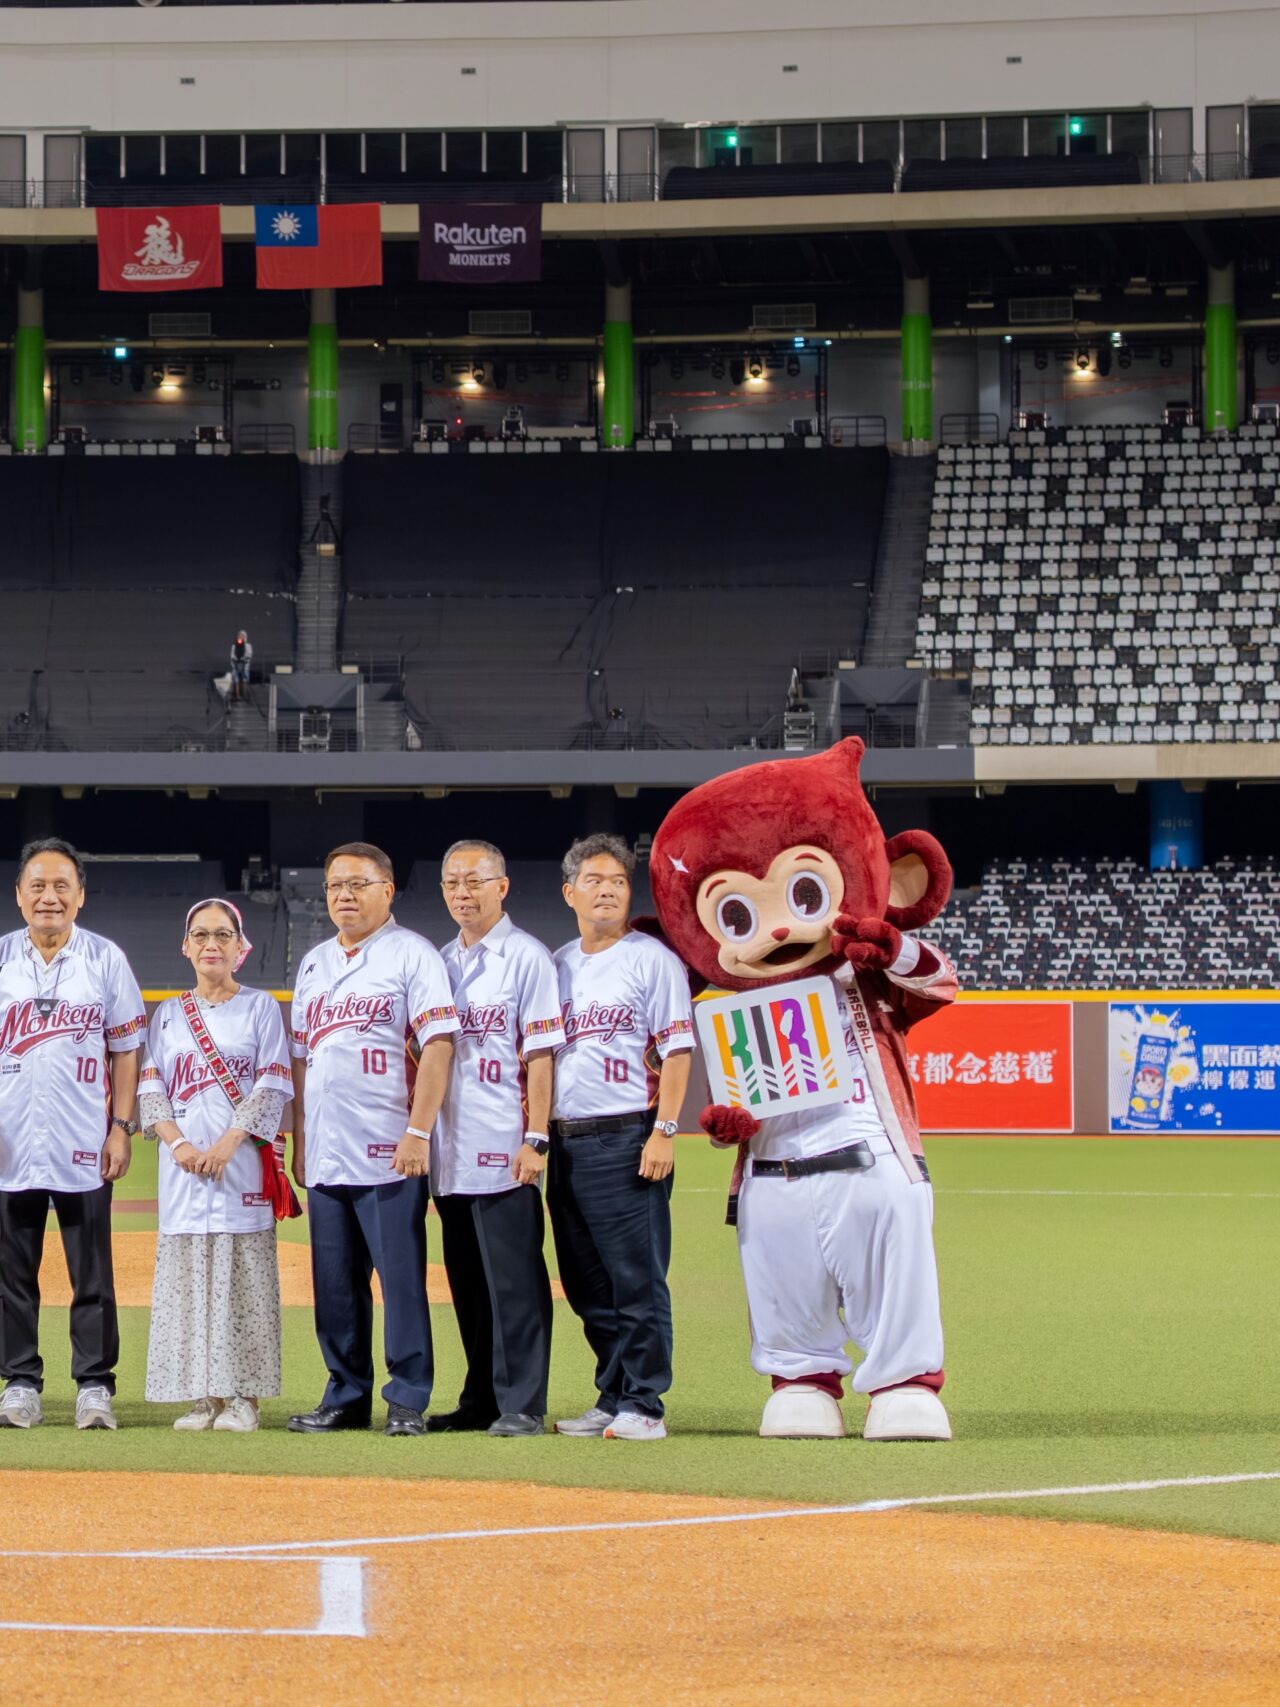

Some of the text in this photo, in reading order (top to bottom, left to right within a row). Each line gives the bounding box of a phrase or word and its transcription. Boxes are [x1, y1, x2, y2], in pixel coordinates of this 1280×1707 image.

[434, 222, 526, 250] Rakuten
[122, 262, 199, 280] DRAGONS
[449, 253, 511, 266] MONKEYS
[305, 991, 394, 1052] Monkeys
[456, 1001, 508, 1046] nkeys
[847, 988, 874, 1054] BASEBALL
[362, 1048, 387, 1075] 10
[712, 992, 839, 1108] KIRI
[76, 1056, 98, 1084] 10
[168, 1050, 253, 1105] Moneys
[479, 1057, 501, 1084] 10
[604, 1057, 629, 1083] 10
[1201, 1069, 1276, 1091] 檸檬運
